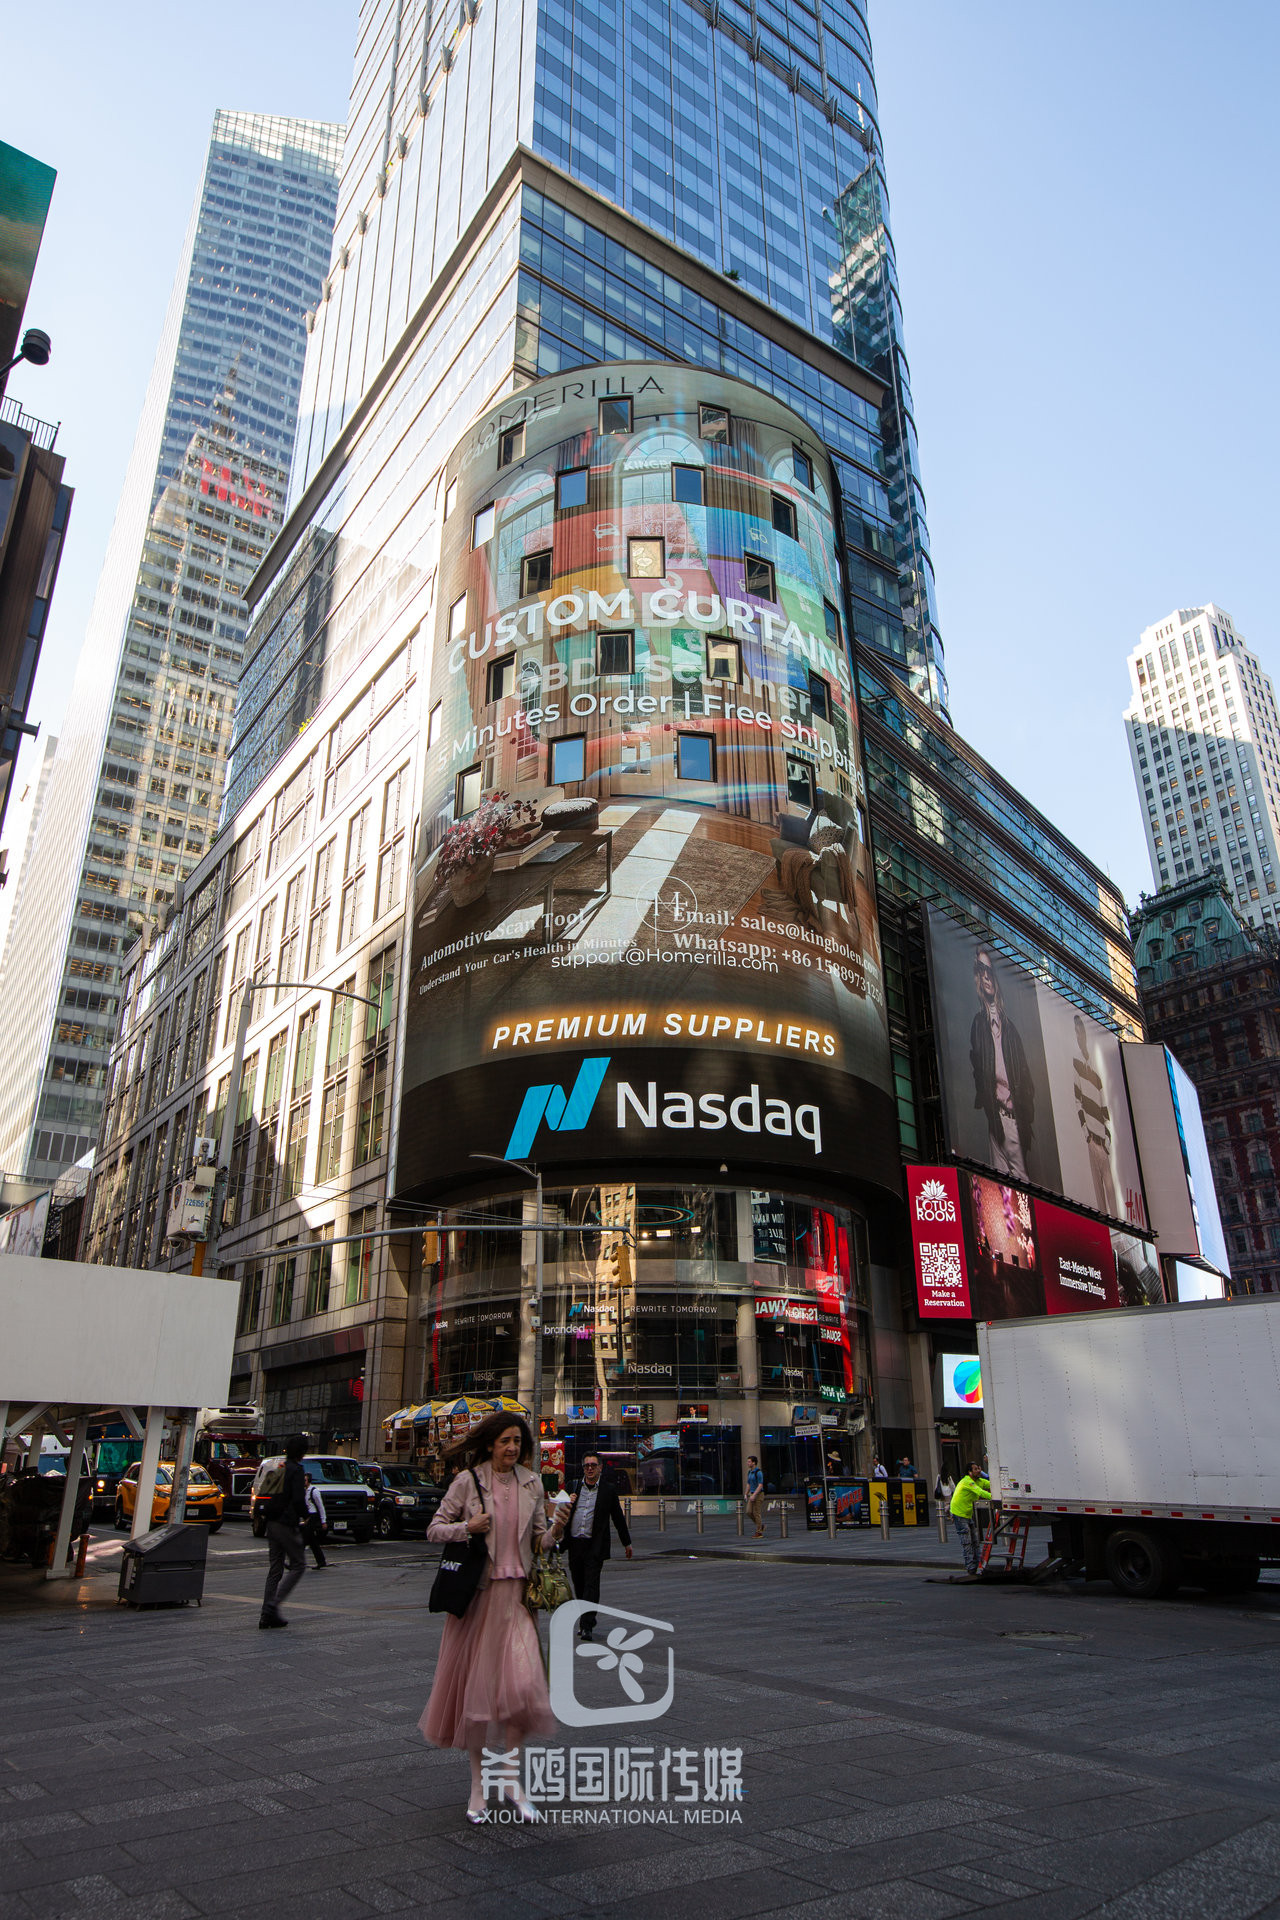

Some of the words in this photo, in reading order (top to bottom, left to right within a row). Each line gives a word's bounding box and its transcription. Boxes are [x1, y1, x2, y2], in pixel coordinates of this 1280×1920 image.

[468, 375, 666, 449] OMERILLA
[448, 588, 630, 675] CUSTOM
[649, 588, 851, 694] CURTAINS
[452, 702, 560, 761] Minutes
[569, 689, 673, 717] Order
[704, 694, 773, 731] Free
[780, 715, 865, 797] Shipping
[421, 928, 492, 972] Automotive
[496, 918, 536, 939] Scan
[541, 907, 584, 929] Tool
[673, 906, 735, 927] Email:
[741, 915, 880, 981] sales@kingbolen.com
[673, 932, 777, 962] Whatsapp:
[782, 948, 811, 968] +86
[419, 965, 461, 996] Understand
[464, 957, 488, 974] Your
[493, 949, 521, 966] Car's
[523, 941, 564, 959] Health
[583, 936, 638, 949] Minutes
[551, 946, 779, 974] support@Homerilla.com
[493, 1012, 647, 1049] PREMIUM
[664, 1013, 837, 1057] SUPPLIERS
[616, 1081, 822, 1155] Nasdaq
[915, 1198, 955, 1213] LOTUS
[917, 1209, 956, 1223] ROOM
[1058, 1256, 1102, 1281] East-Meets-West
[931, 1290, 951, 1298] Make
[1059, 1273, 1089, 1293] Immersive
[1088, 1281, 1107, 1301] Dining
[477, 1311, 513, 1322] TOMORROW
[583, 1304, 615, 1315] Nasdaq
[630, 1305, 667, 1313] REWRITE
[671, 1305, 718, 1314] TOMORROW
[924, 1298, 965, 1308] Reservation
[627, 1361, 673, 1377] Nasdaq
